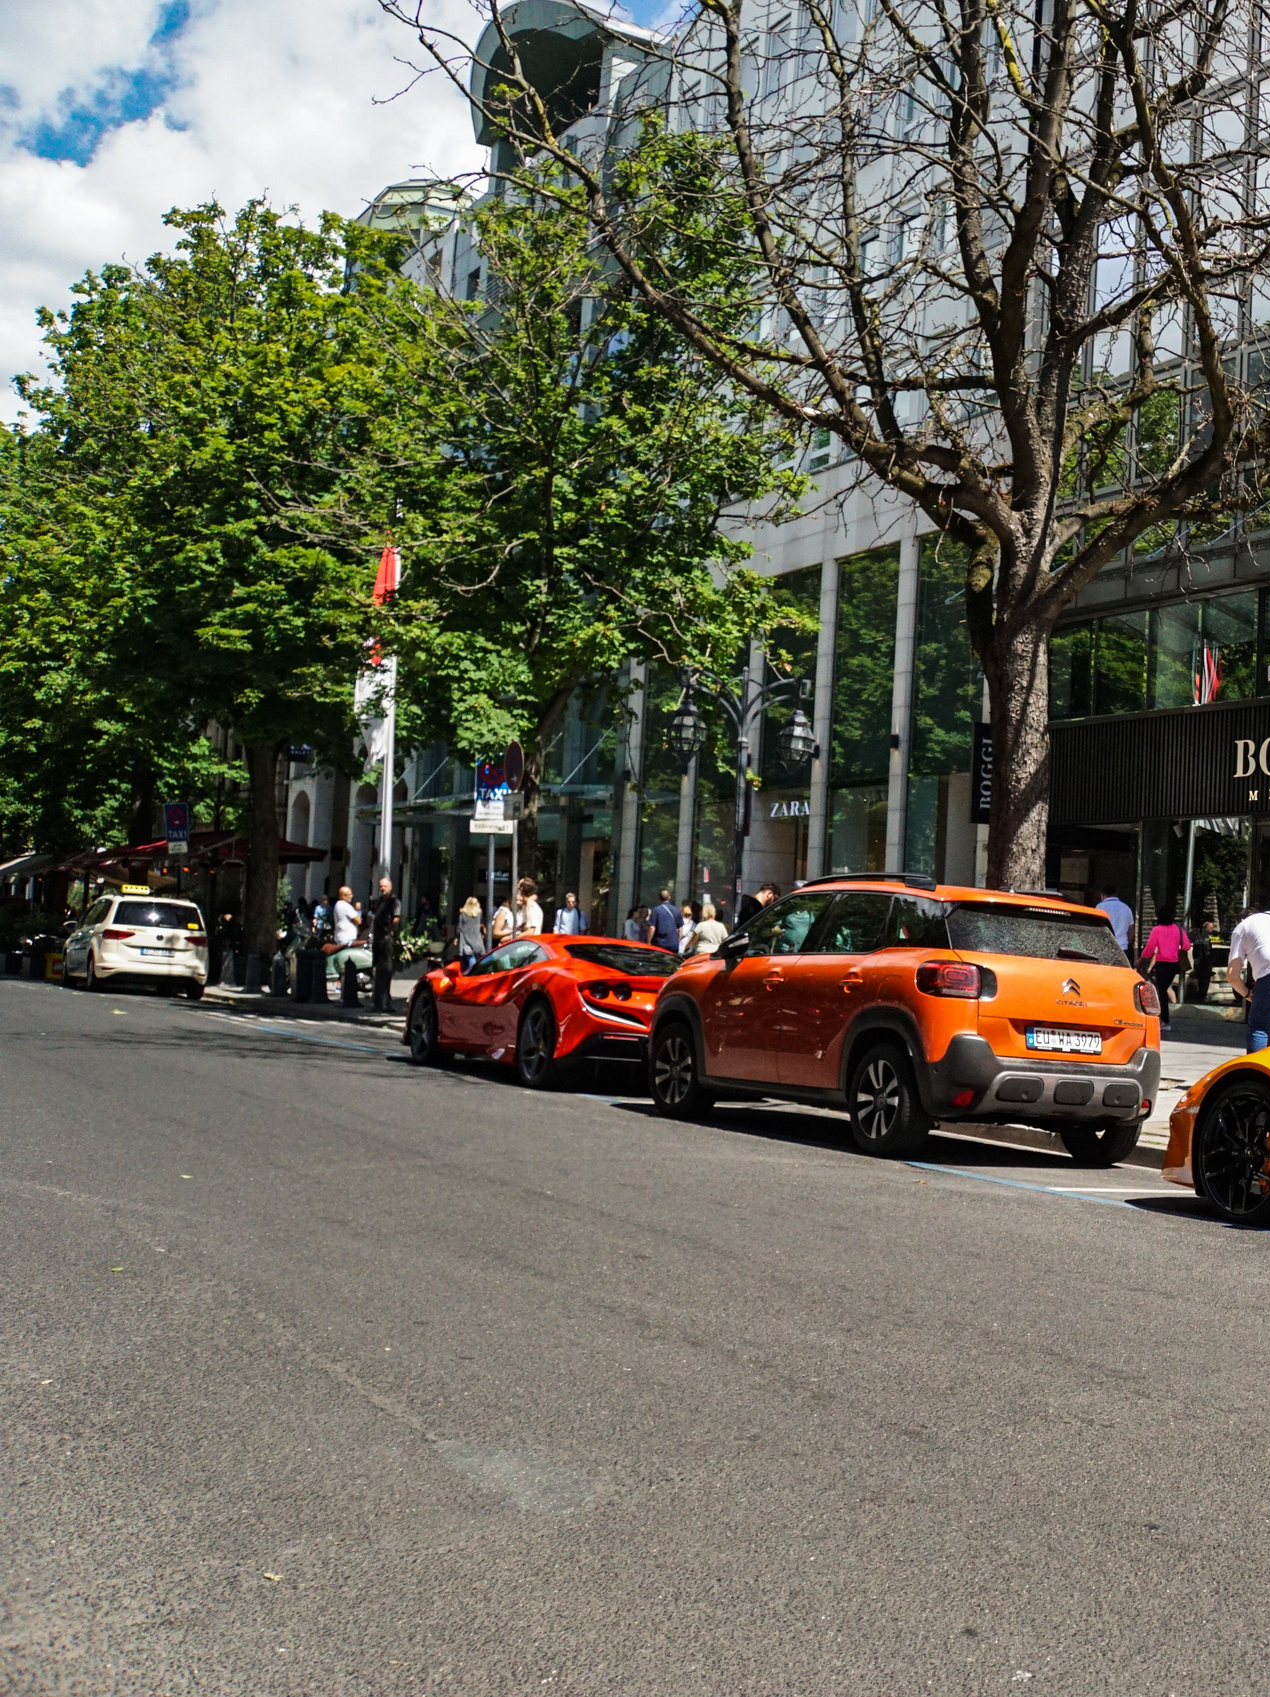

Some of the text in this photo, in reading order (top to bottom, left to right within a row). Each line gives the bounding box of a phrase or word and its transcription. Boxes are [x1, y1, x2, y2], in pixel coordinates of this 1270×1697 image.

[770, 801, 811, 818] ZARA
[168, 830, 187, 839] TAXI
[1035, 1029, 1101, 1049] EU WA 3979
